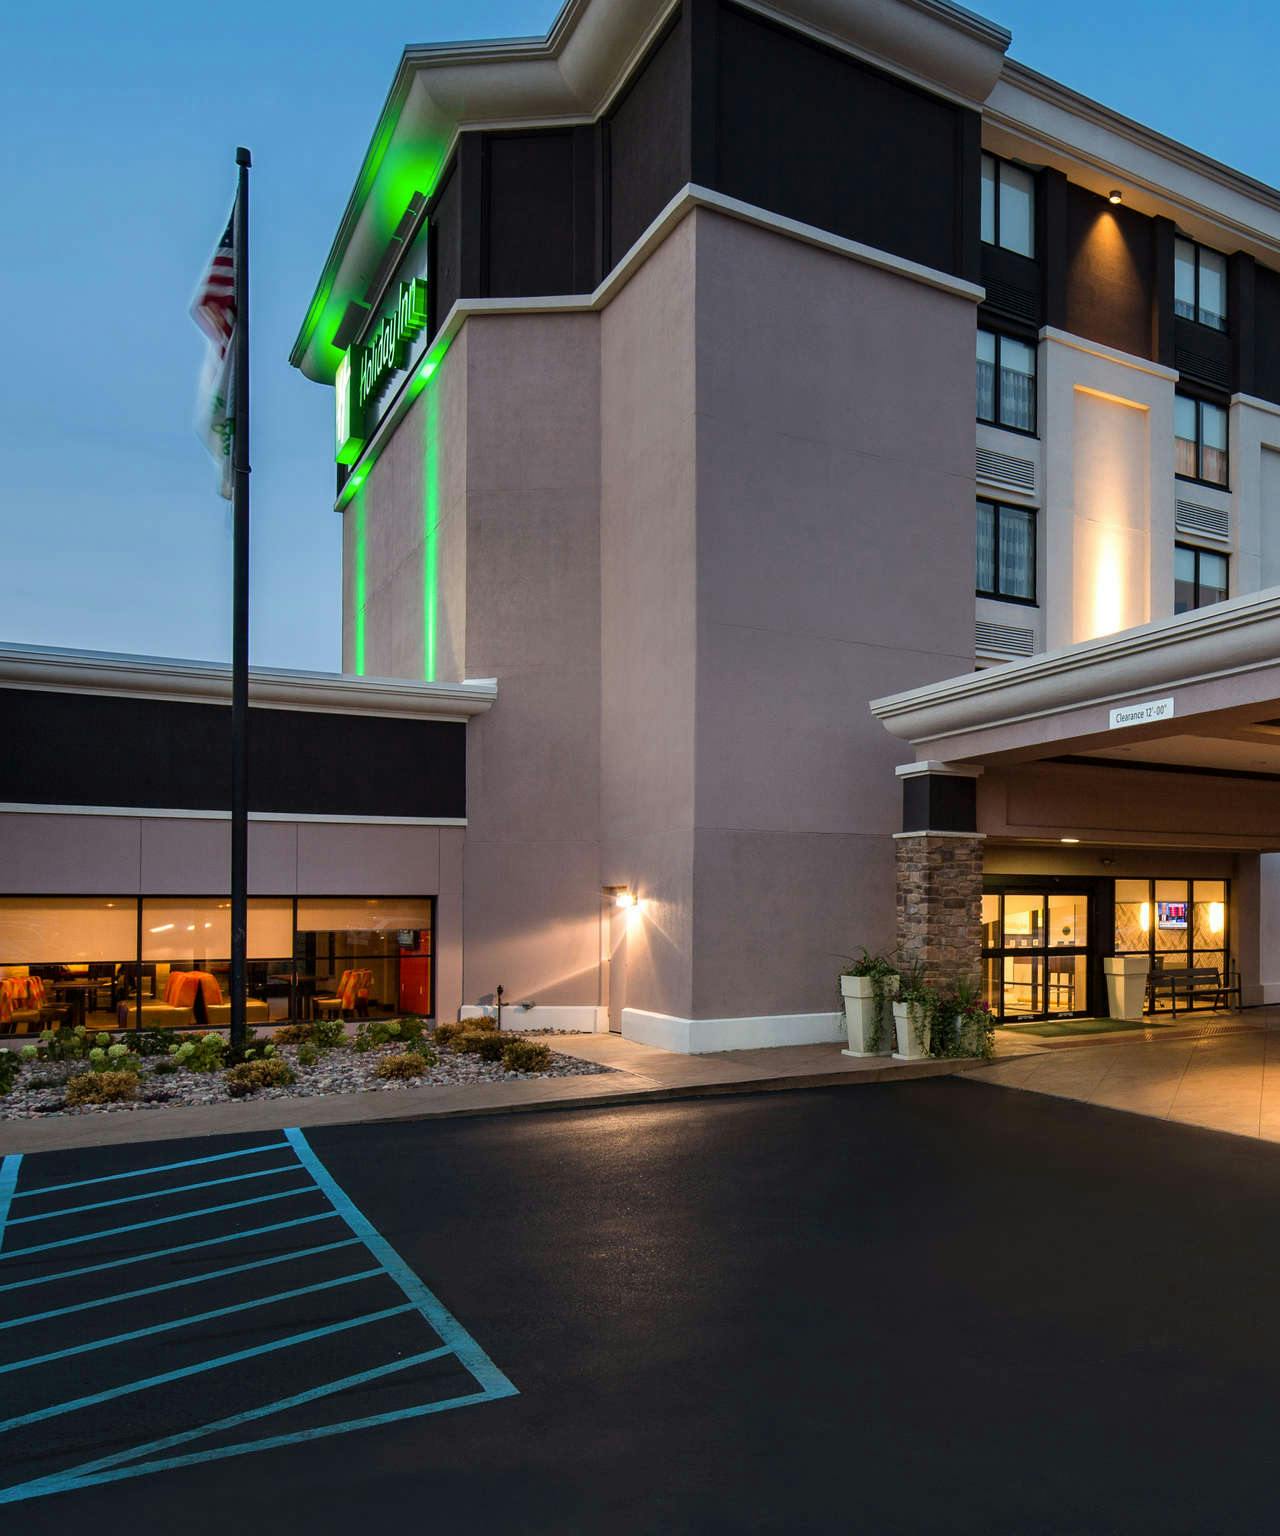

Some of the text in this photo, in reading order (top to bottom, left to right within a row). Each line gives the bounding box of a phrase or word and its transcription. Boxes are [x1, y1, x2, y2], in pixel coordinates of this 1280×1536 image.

[359, 277, 420, 407] Holiday Inn
[1115, 710, 1145, 723] Clearance
